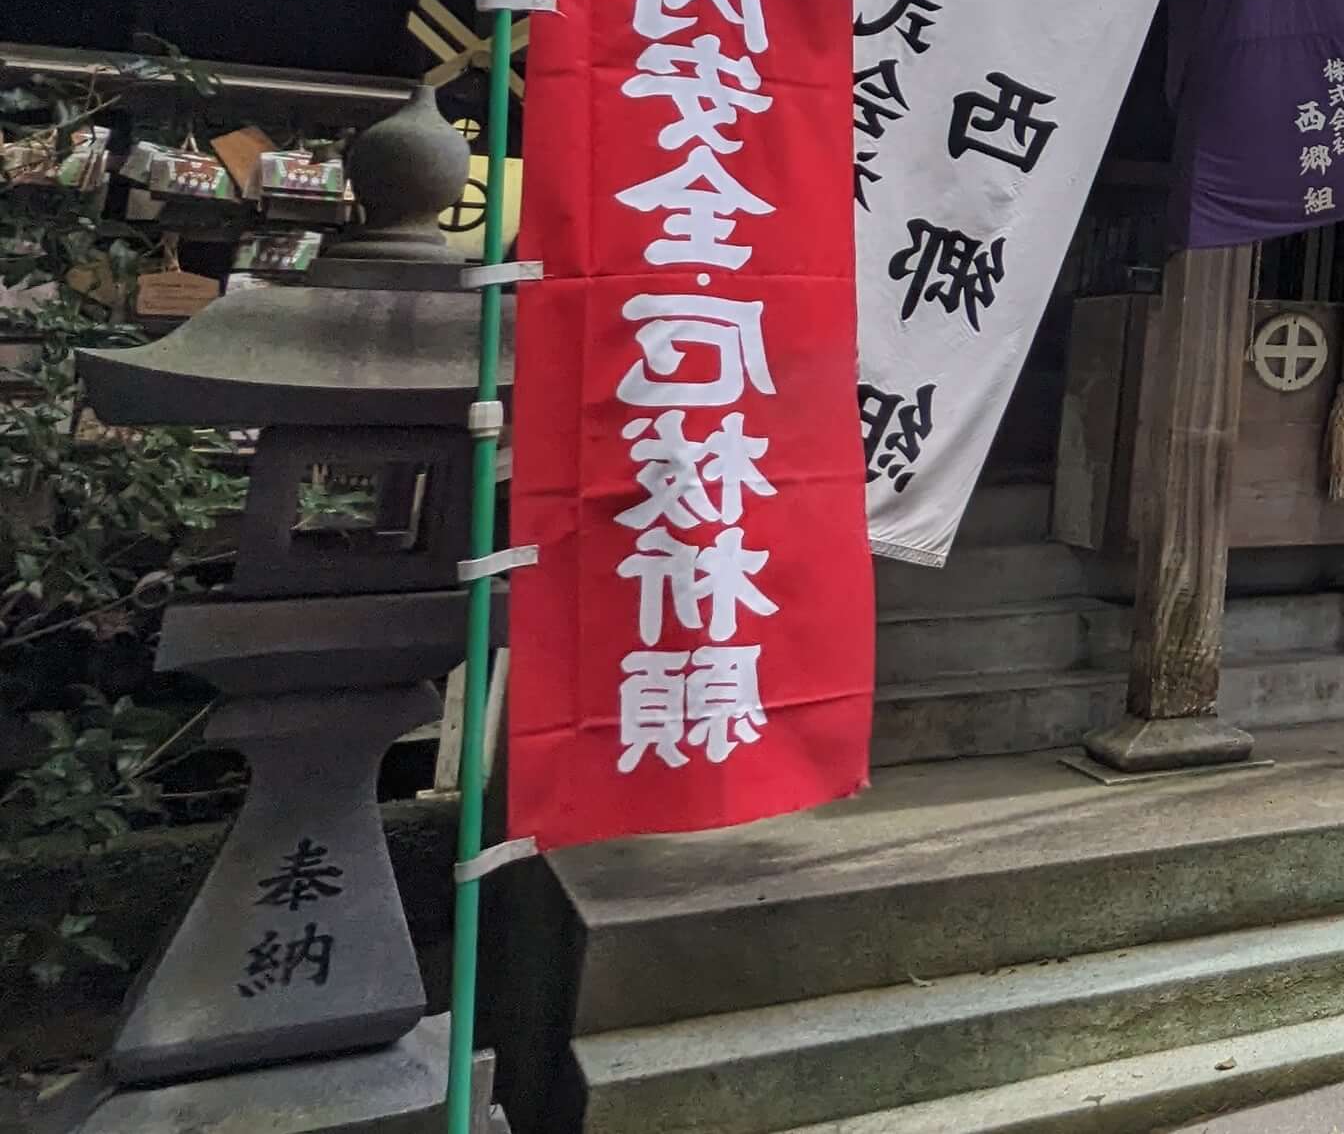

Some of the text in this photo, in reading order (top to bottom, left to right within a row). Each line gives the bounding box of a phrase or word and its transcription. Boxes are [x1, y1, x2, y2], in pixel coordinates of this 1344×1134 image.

[1294, 100, 1336, 215] 西郷組
[236, 836, 344, 998] 奉納
